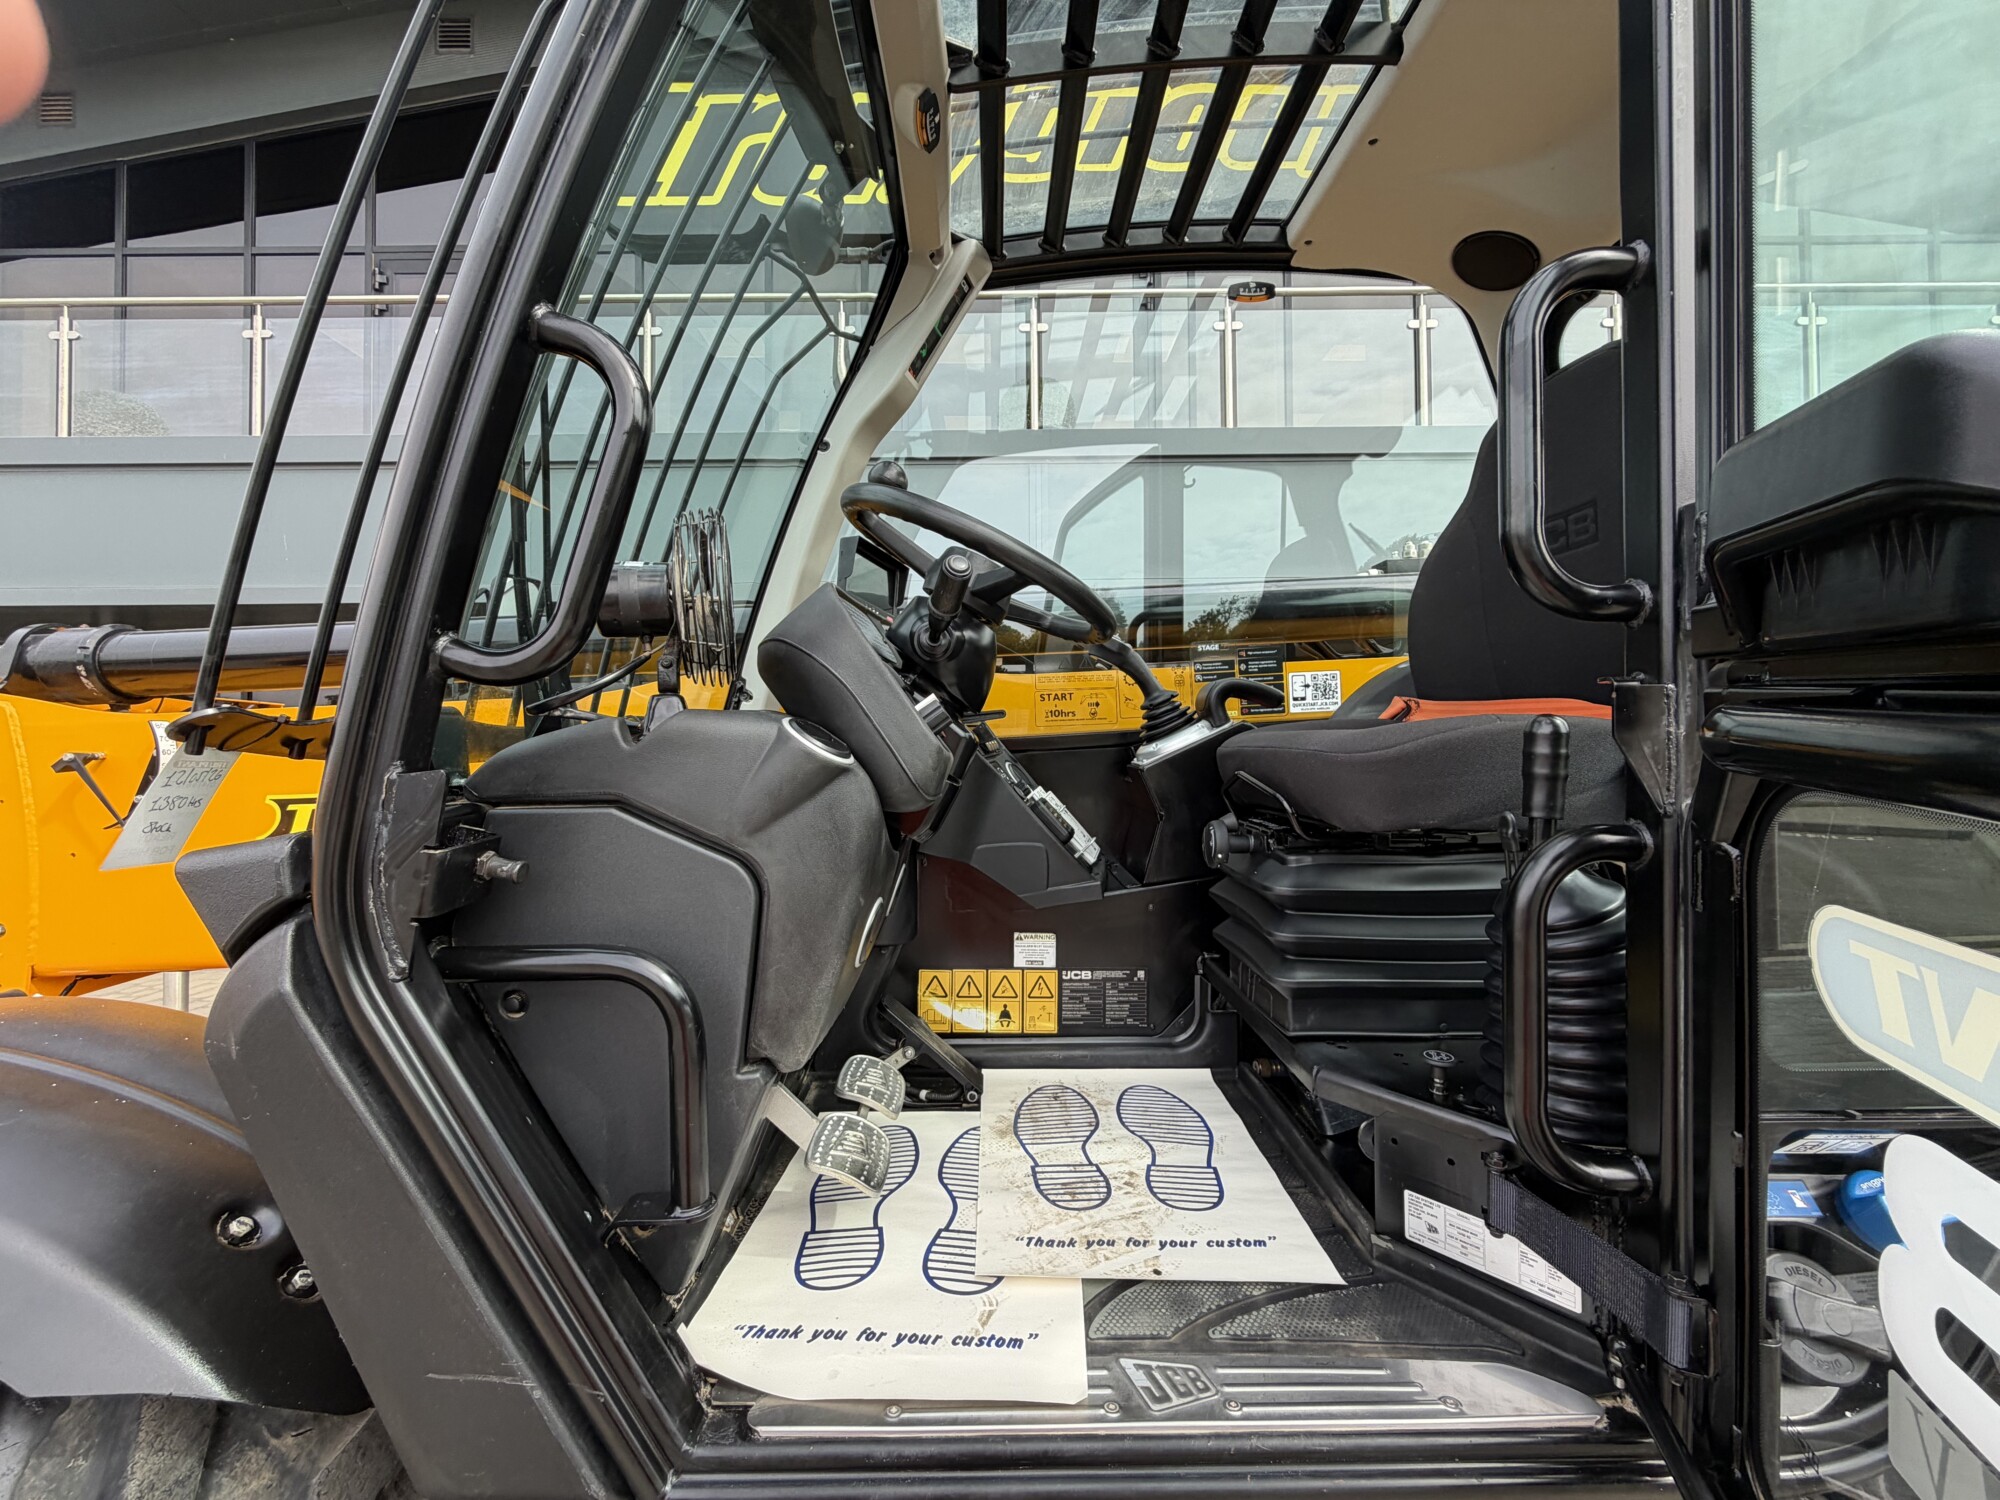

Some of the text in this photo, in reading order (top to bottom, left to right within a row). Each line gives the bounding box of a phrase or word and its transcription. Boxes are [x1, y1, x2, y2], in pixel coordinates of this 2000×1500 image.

[1197, 643, 1220, 652] STAGE
[1040, 692, 1074, 702] START
[1049, 708, 1077, 718] 10hrs
[1062, 970, 1092, 980] JCB
[1085, 1238, 1116, 1250] you
[1125, 1237, 1150, 1249] for
[1159, 1238, 1197, 1250] your
[1784, 1265, 1824, 1288] DIESEL
[807, 1328, 848, 1344] you
[856, 1327, 887, 1343] for
[892, 1332, 943, 1348] your
[1131, 1362, 1214, 1406] JCB
